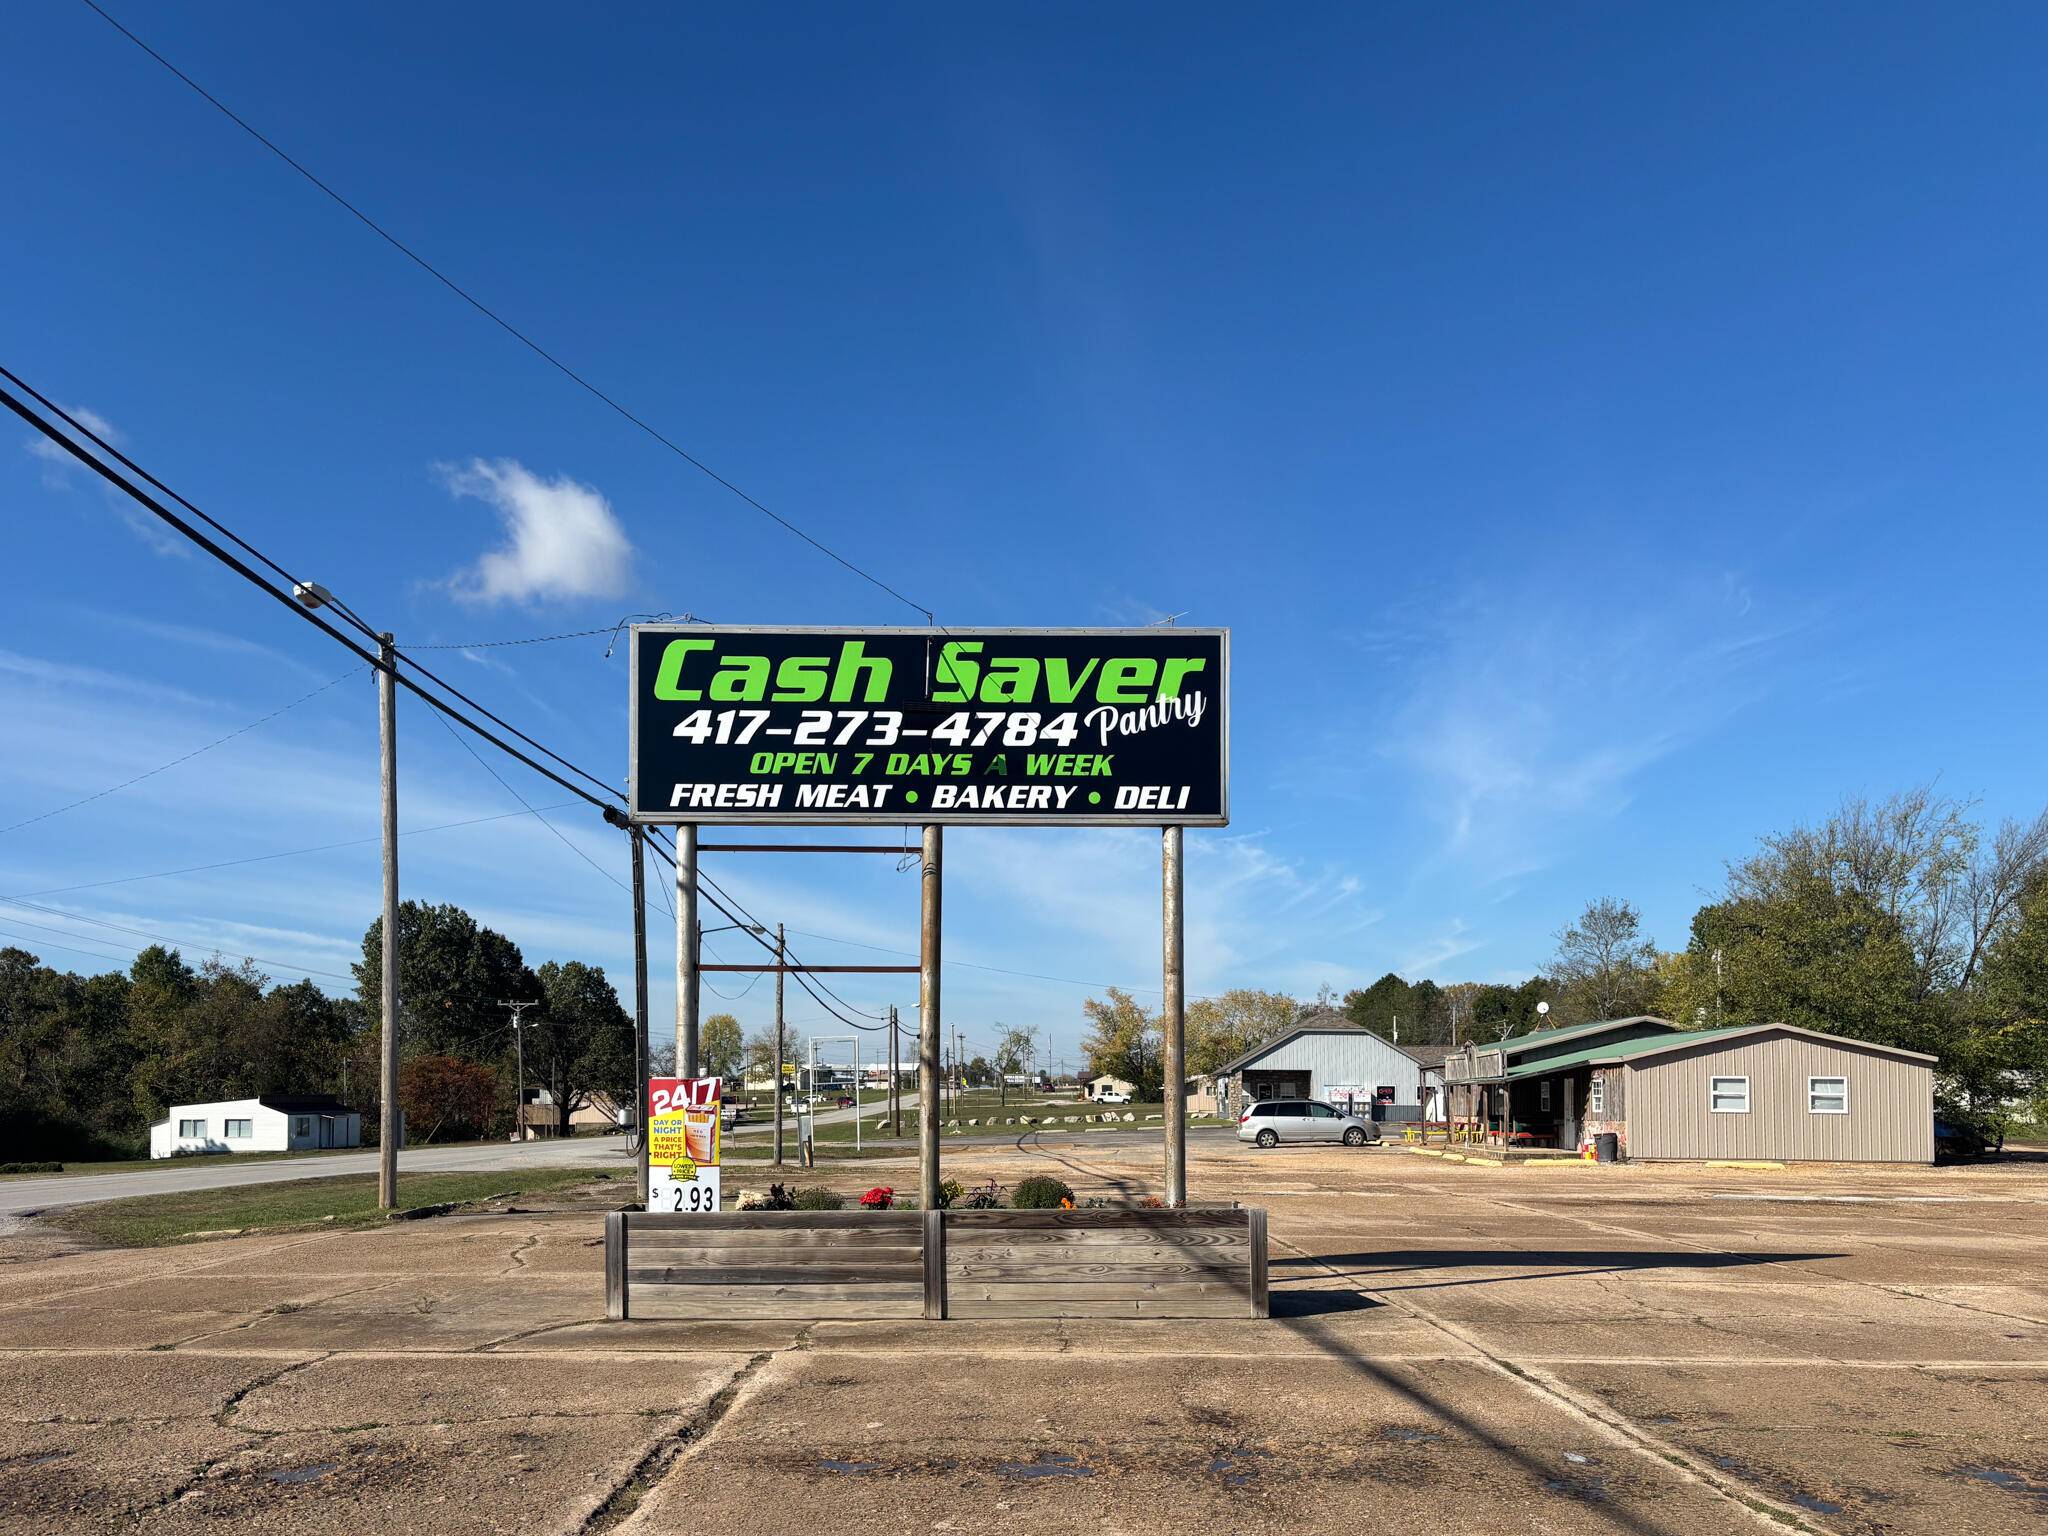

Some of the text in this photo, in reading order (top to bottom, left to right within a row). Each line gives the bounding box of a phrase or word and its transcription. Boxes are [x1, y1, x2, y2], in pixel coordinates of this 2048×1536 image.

[653, 639, 1208, 704] Cash Saver
[673, 710, 1079, 747] 417-273-4784
[1084, 690, 1207, 747] Pantry
[750, 752, 1115, 777] OPEN 7 DAYS A WEEK
[670, 784, 1191, 810] FRESH MEAT BAKERY DELI
[653, 1127, 683, 1135] NIGHT
[653, 1143, 683, 1151] THAT'S
[653, 1151, 683, 1160] RIGHT
[674, 1186, 713, 1212] 2.93
